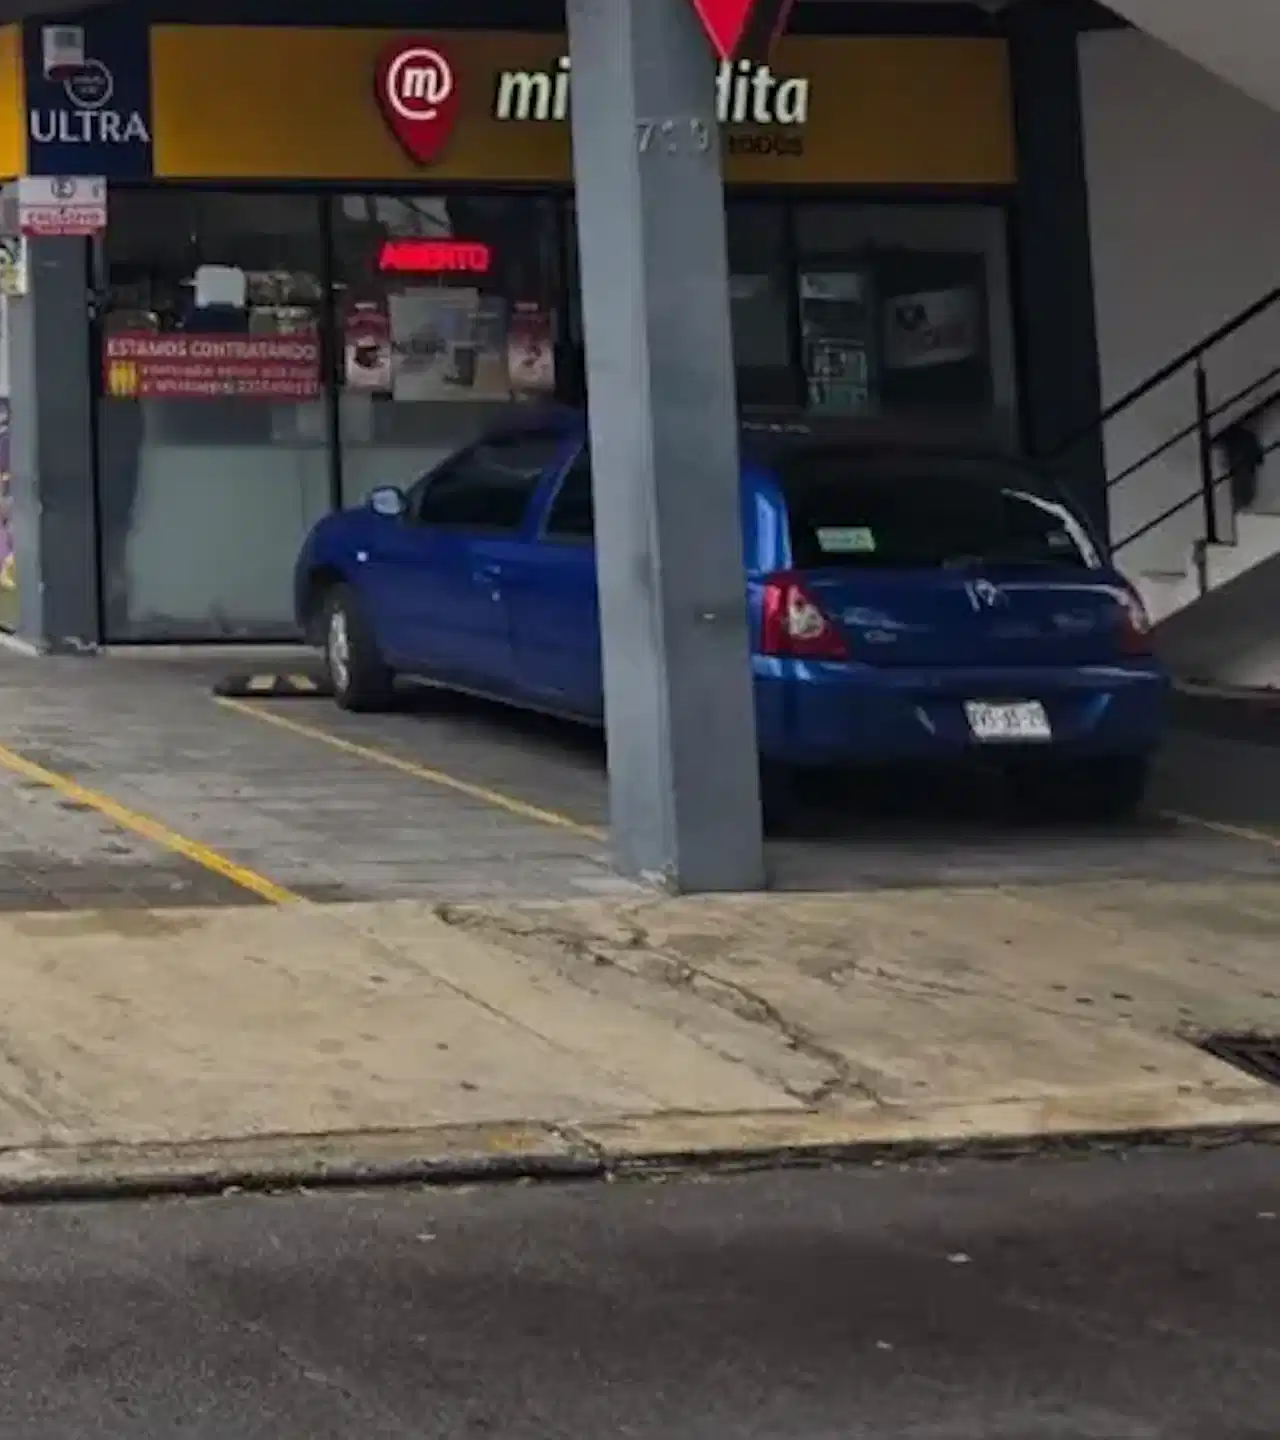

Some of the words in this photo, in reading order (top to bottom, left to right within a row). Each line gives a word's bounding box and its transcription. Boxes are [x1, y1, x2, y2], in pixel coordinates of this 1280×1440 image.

[496, 55, 571, 120] mi
[28, 107, 151, 144] ULTRA
[105, 336, 188, 358] ESTAMOS
[191, 339, 318, 361] CONTRATANDO
